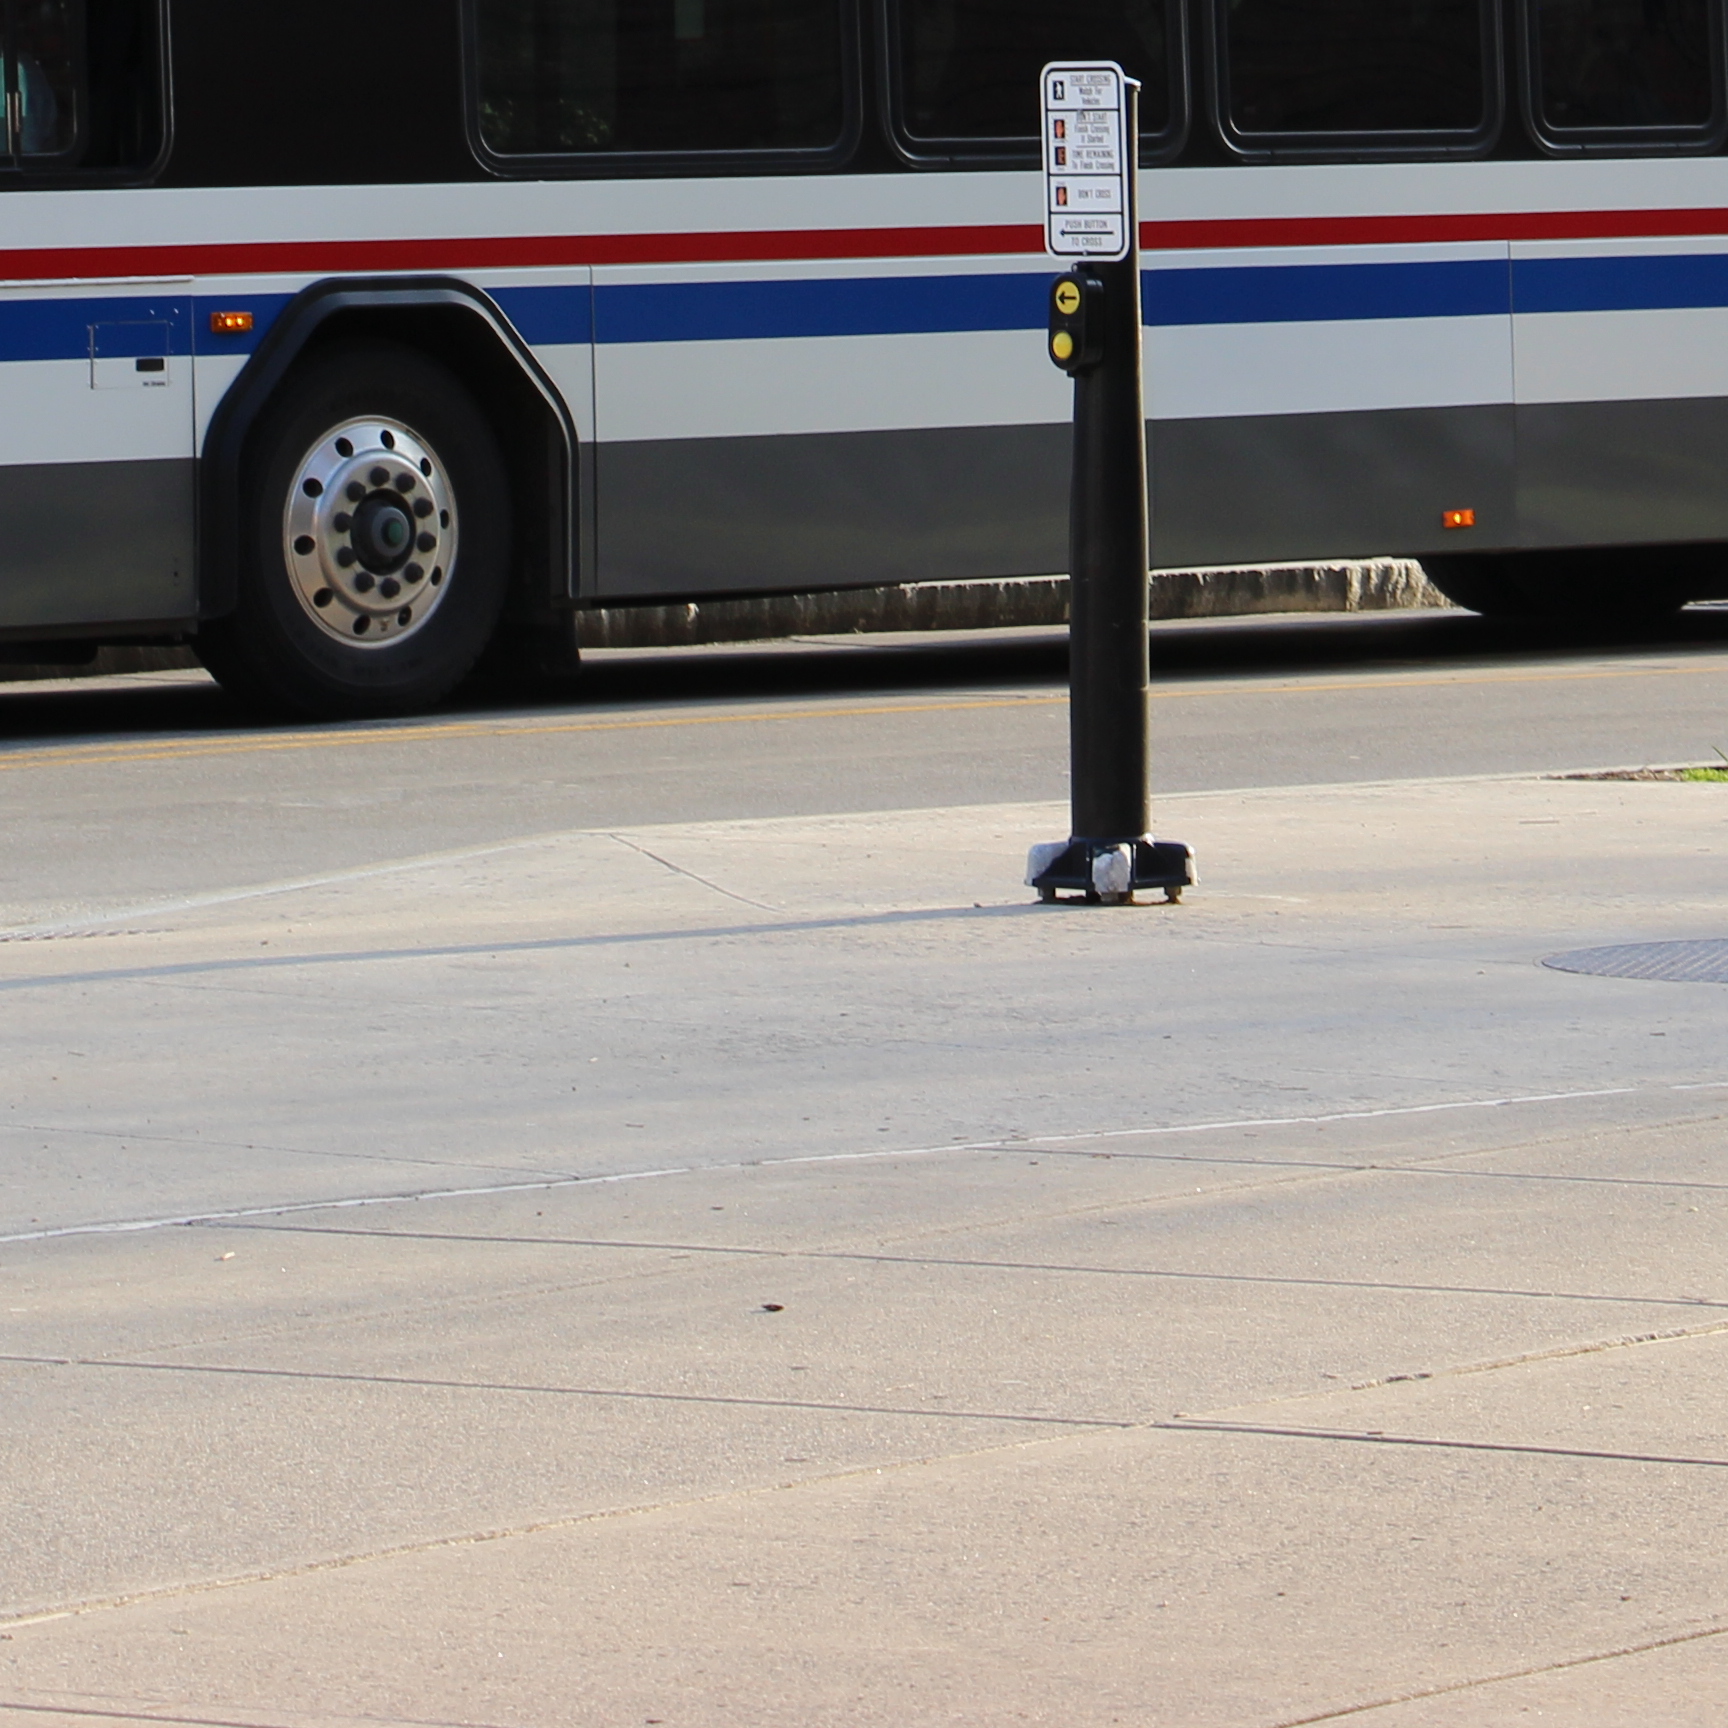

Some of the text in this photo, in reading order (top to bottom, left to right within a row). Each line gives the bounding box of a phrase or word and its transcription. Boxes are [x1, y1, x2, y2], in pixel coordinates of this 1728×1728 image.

[1065, 219, 1108, 229] PUSH BUTTON
[1071, 237, 1102, 246] TO CROSS
